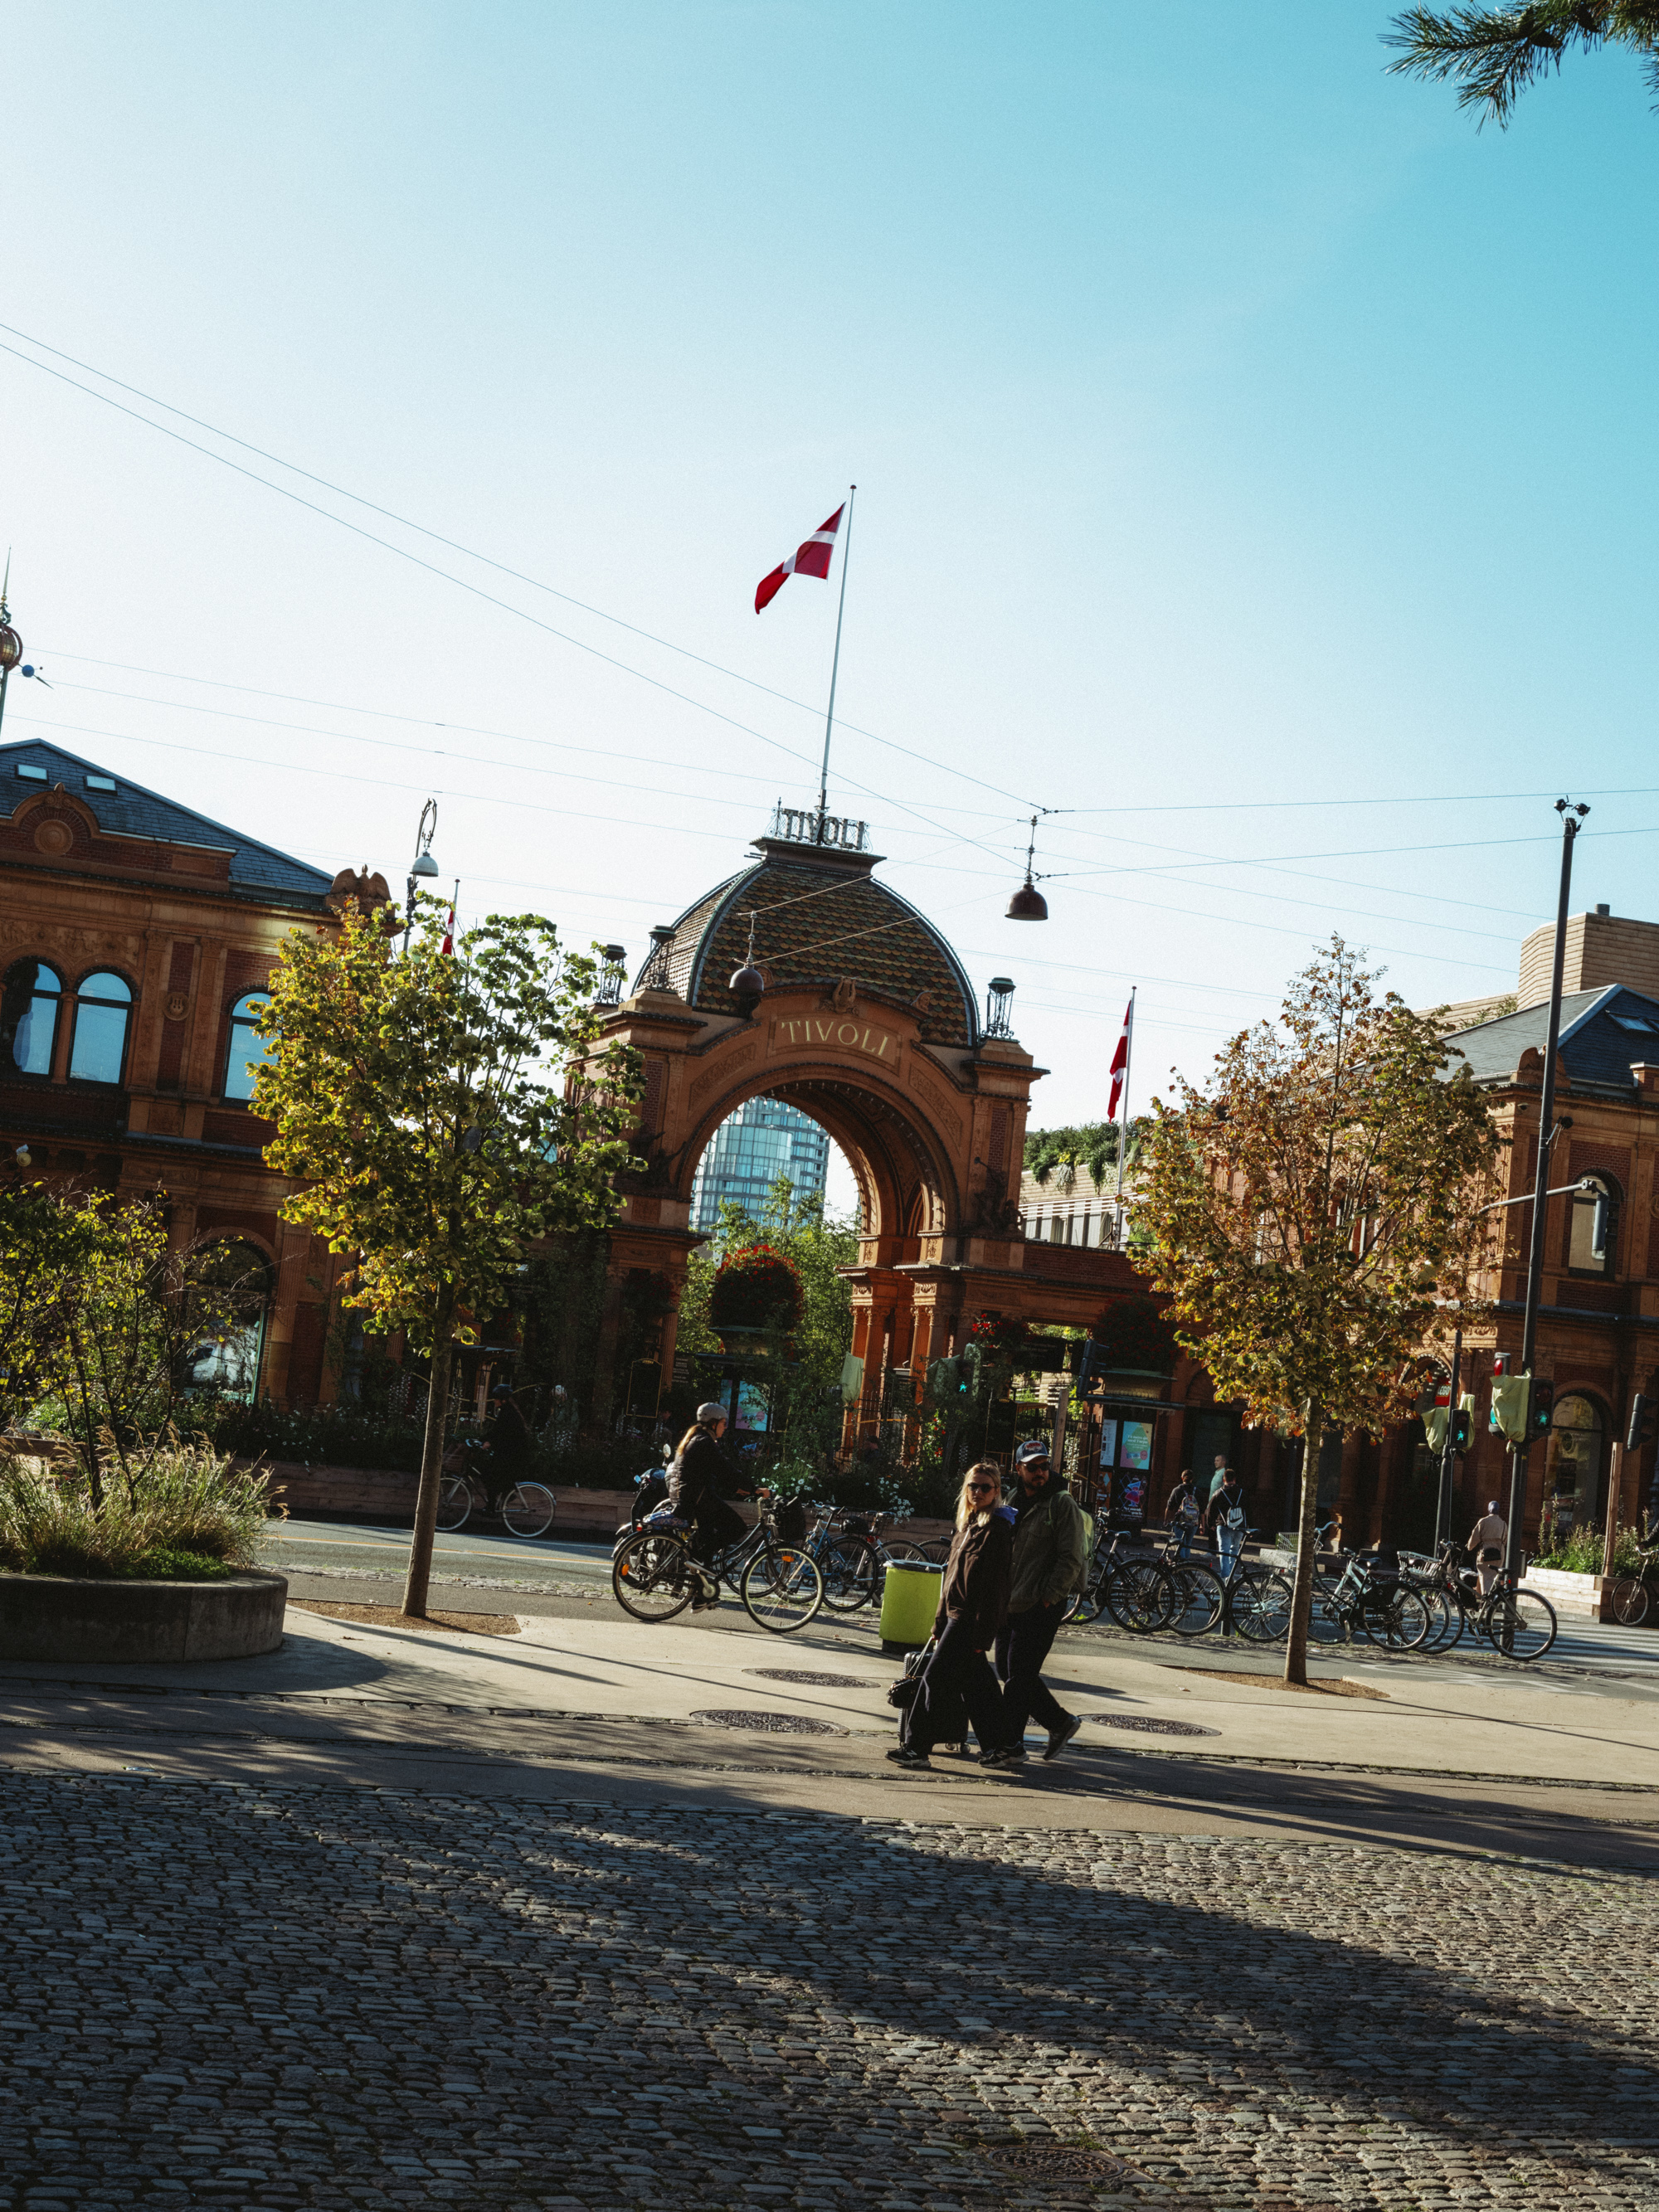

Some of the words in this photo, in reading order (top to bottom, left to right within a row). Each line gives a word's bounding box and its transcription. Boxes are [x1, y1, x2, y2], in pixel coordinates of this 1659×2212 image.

[781, 808, 864, 850] TIVOLI
[781, 1020, 888, 1056] TIVOLI
[1438, 1385, 1450, 1395] LEGO
